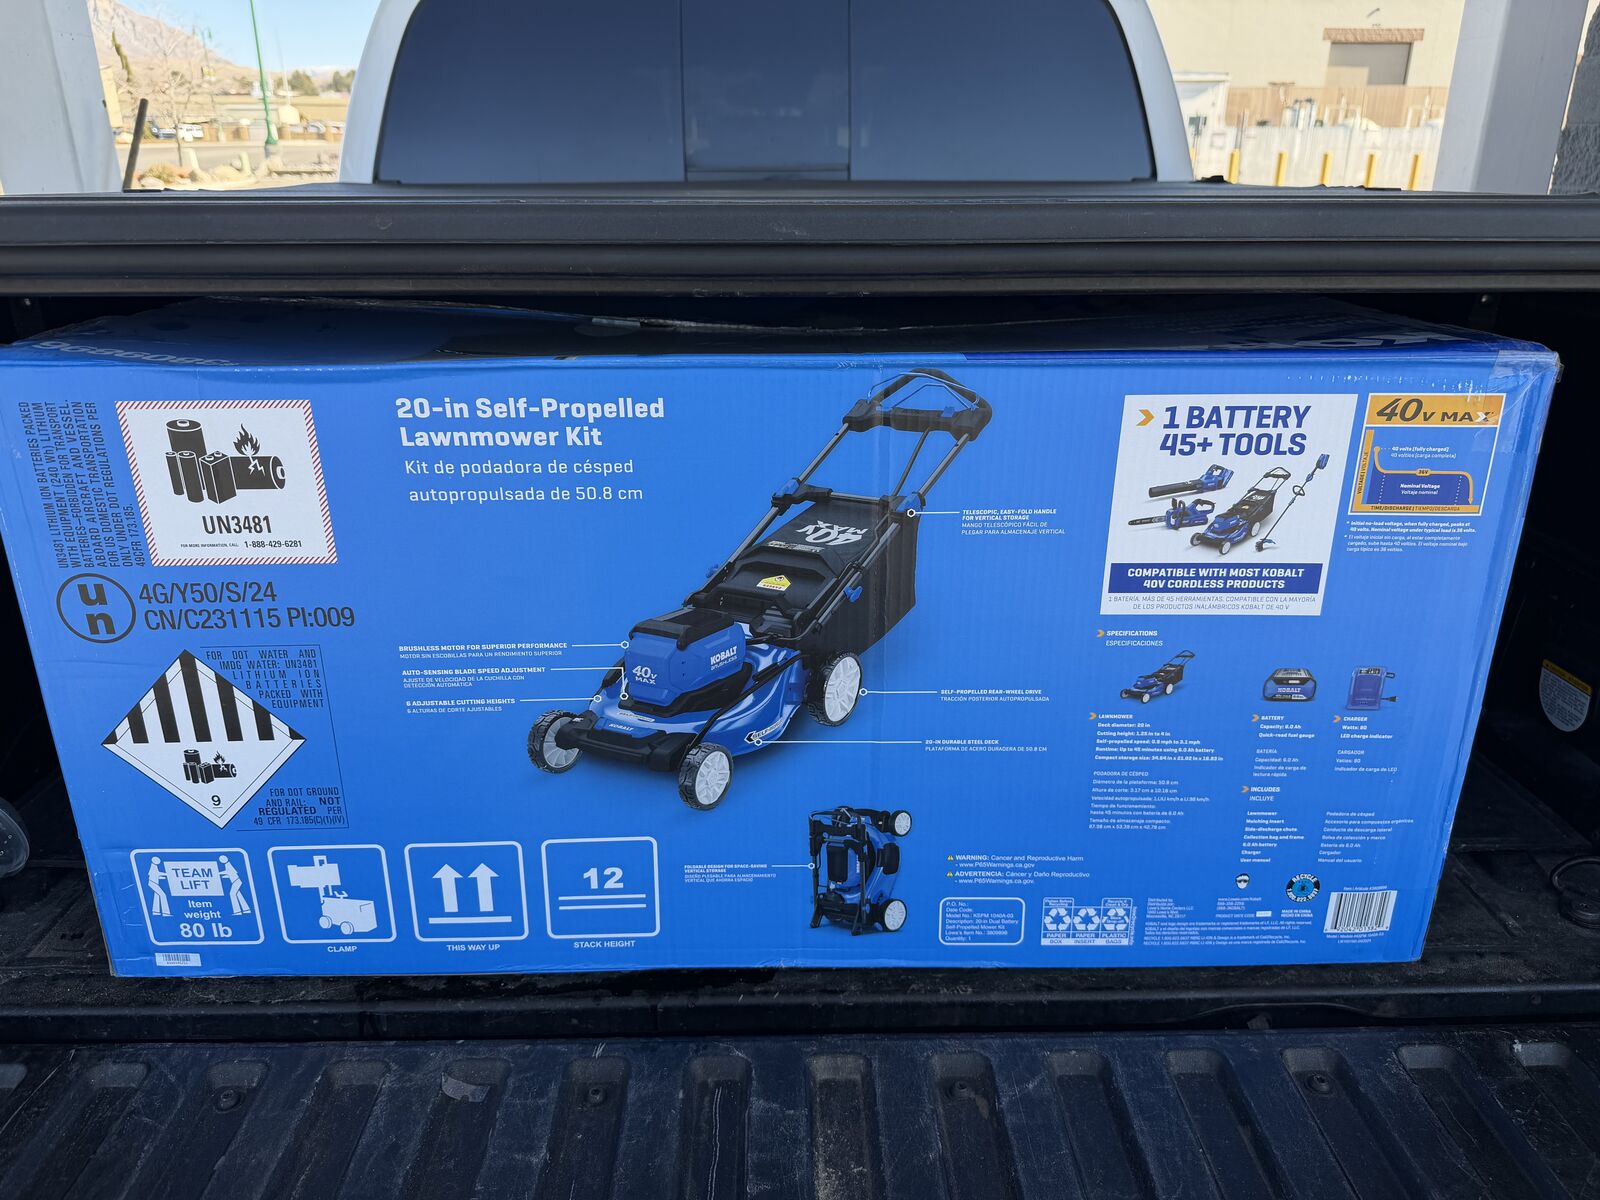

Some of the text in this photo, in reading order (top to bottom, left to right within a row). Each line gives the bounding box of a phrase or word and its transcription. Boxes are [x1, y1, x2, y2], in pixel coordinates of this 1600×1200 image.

[396, 397, 664, 423] 20-in Self-Propelled
[1163, 406, 1311, 429] 1 BATTERY
[45, 402, 65, 450] TRANSPORT
[401, 426, 602, 447] Lawnmower Kit
[1160, 433, 1307, 456] 45+ TOOLS
[58, 454, 70, 470] FOR
[405, 459, 633, 477] Kit de podadora de césped
[19, 402, 68, 568] UN3481 LITHIUM ION BATTERIES PACKED
[32, 403, 81, 567] WITH EQUIPMENT (240 Wh) LITHIUM
[58, 400, 107, 567] ABOARD AIRCRAFT AND VESSEL.
[71, 402, 120, 567] FOR US DOMESTIC TRANSPORTATION
[85, 402, 133, 566] ONLY UNDER DOT REGULATIONS PER
[409, 487, 642, 504] autopropulsada de 50.8 cm
[202, 515, 271, 534] UN3481
[244, 540, 302, 548] 1-888-429-6281
[132, 541, 145, 566] 49CFR
[1128, 568, 1304, 577] COMPATIBLE WITH MOST KOBALT
[1144, 580, 1285, 589] 40V CORDLESS PRODUCTS
[139, 581, 277, 604] 4G/Y50/S/24
[144, 608, 281, 630] CN/C231115
[207, 650, 316, 660] FOR DOT WATER AND
[711, 646, 737, 664] KOBALT
[220, 660, 317, 670] IMDG WATER: UN3481
[246, 679, 322, 690] BATTERIES
[635, 676, 656, 684] MAX
[259, 689, 323, 699] PACKED WITH
[272, 699, 324, 708] EQUIPMENT
[270, 787, 338, 796] FOR DOT GROUND
[211, 795, 221, 806] 9
[266, 797, 341, 807] AND RAIL: NOT
[258, 806, 342, 816] REGULATED PER
[254, 817, 263, 825] 49
[268, 816, 281, 825] CFR
[172, 868, 213, 878] TEAM
[583, 867, 624, 889] 12
[1292, 873, 1318, 883] RECYCLE
[180, 880, 210, 890] LIFT
[188, 900, 212, 908] Item
[184, 910, 221, 920] weight
[180, 923, 233, 938] 80 lb
[447, 943, 500, 952] THIS WAY UP
